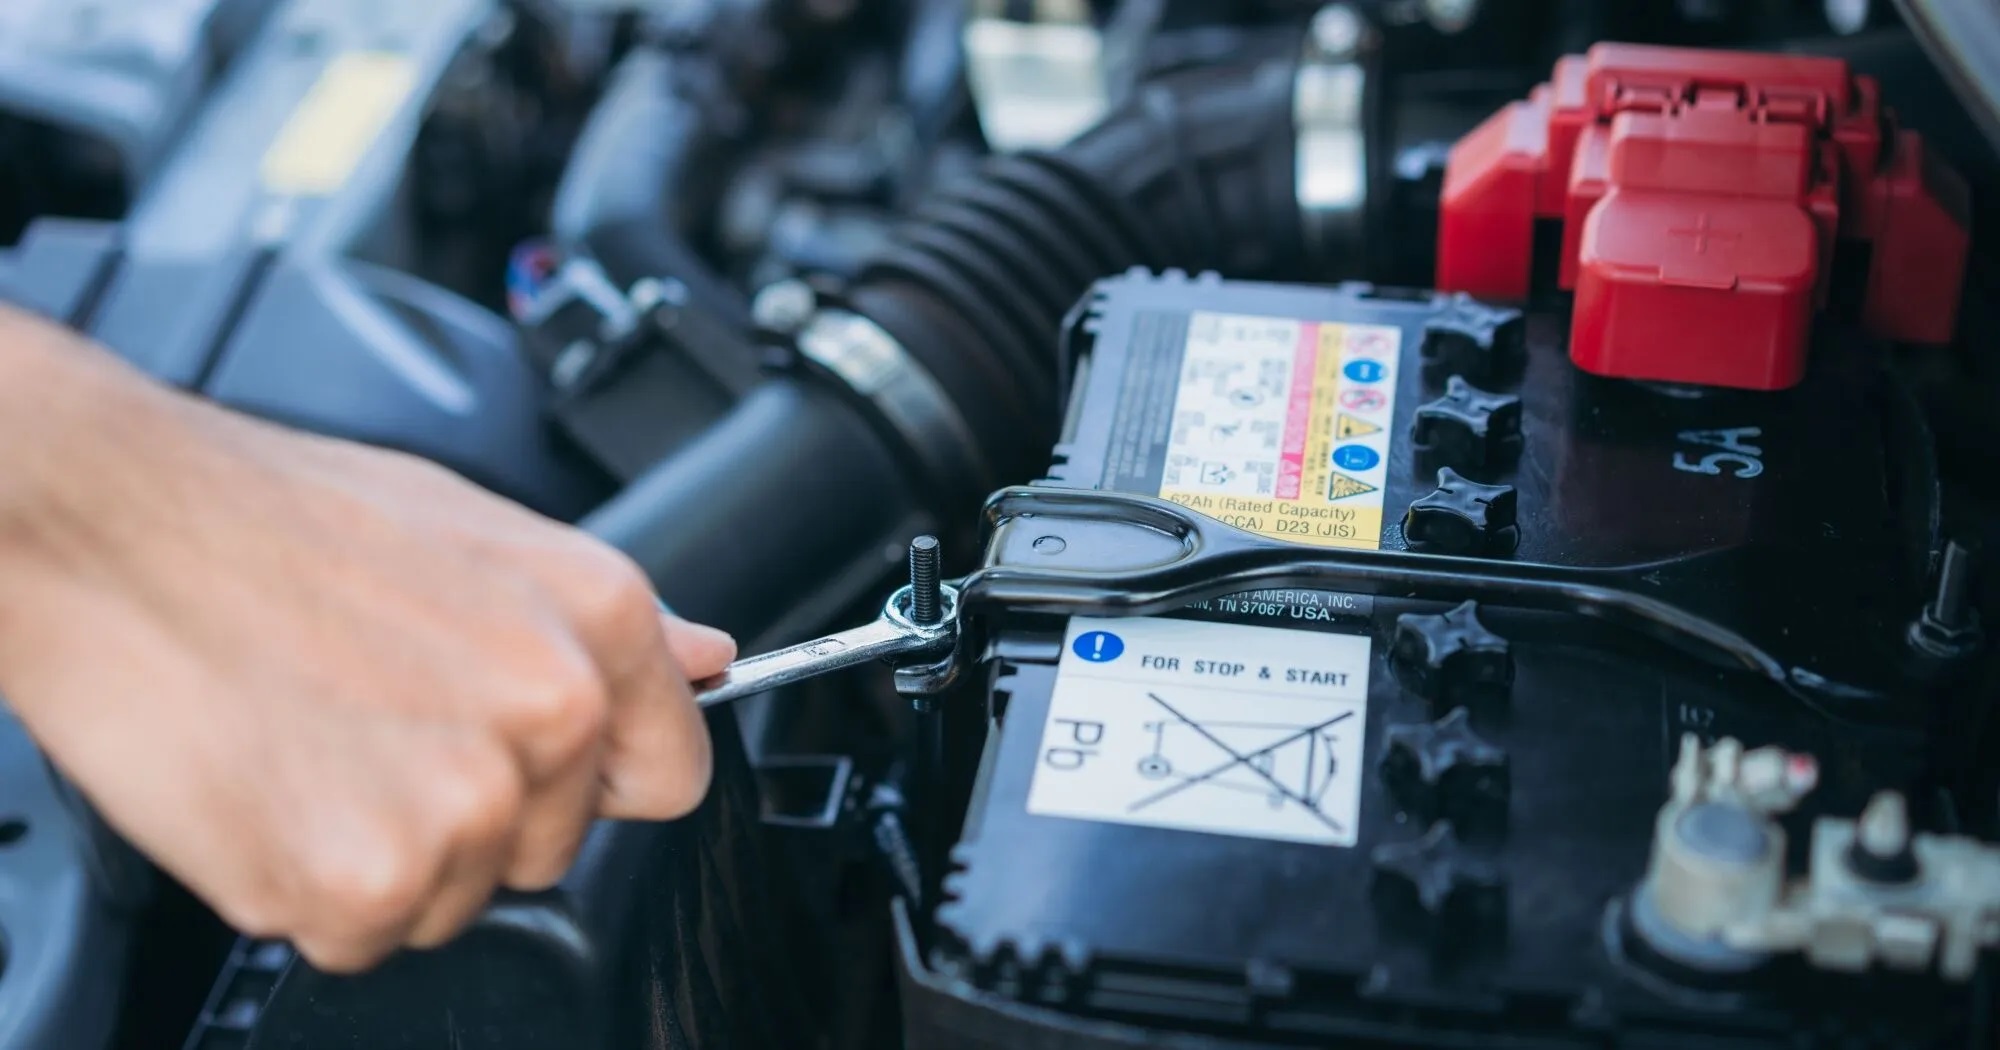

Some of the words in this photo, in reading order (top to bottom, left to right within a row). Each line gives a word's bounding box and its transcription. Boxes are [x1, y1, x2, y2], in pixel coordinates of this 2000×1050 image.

[1672, 426, 1764, 478] 5A
[1219, 497, 1272, 514] (Rated
[1279, 501, 1356, 521] Capacity)
[1276, 519, 1310, 534] D23
[1316, 524, 1357, 538] (JIS)
[1218, 598, 1237, 612] TN
[1240, 601, 1285, 617] 37067
[1290, 606, 1335, 621] USA.
[1252, 590, 1323, 608] AMERICA,
[1328, 595, 1357, 609] INC.
[1141, 655, 1180, 671] FOR
[1194, 659, 1245, 677] STOP
[1258, 666, 1271, 679] &
[1286, 667, 1350, 687] START
[1045, 718, 1105, 770] Pb
